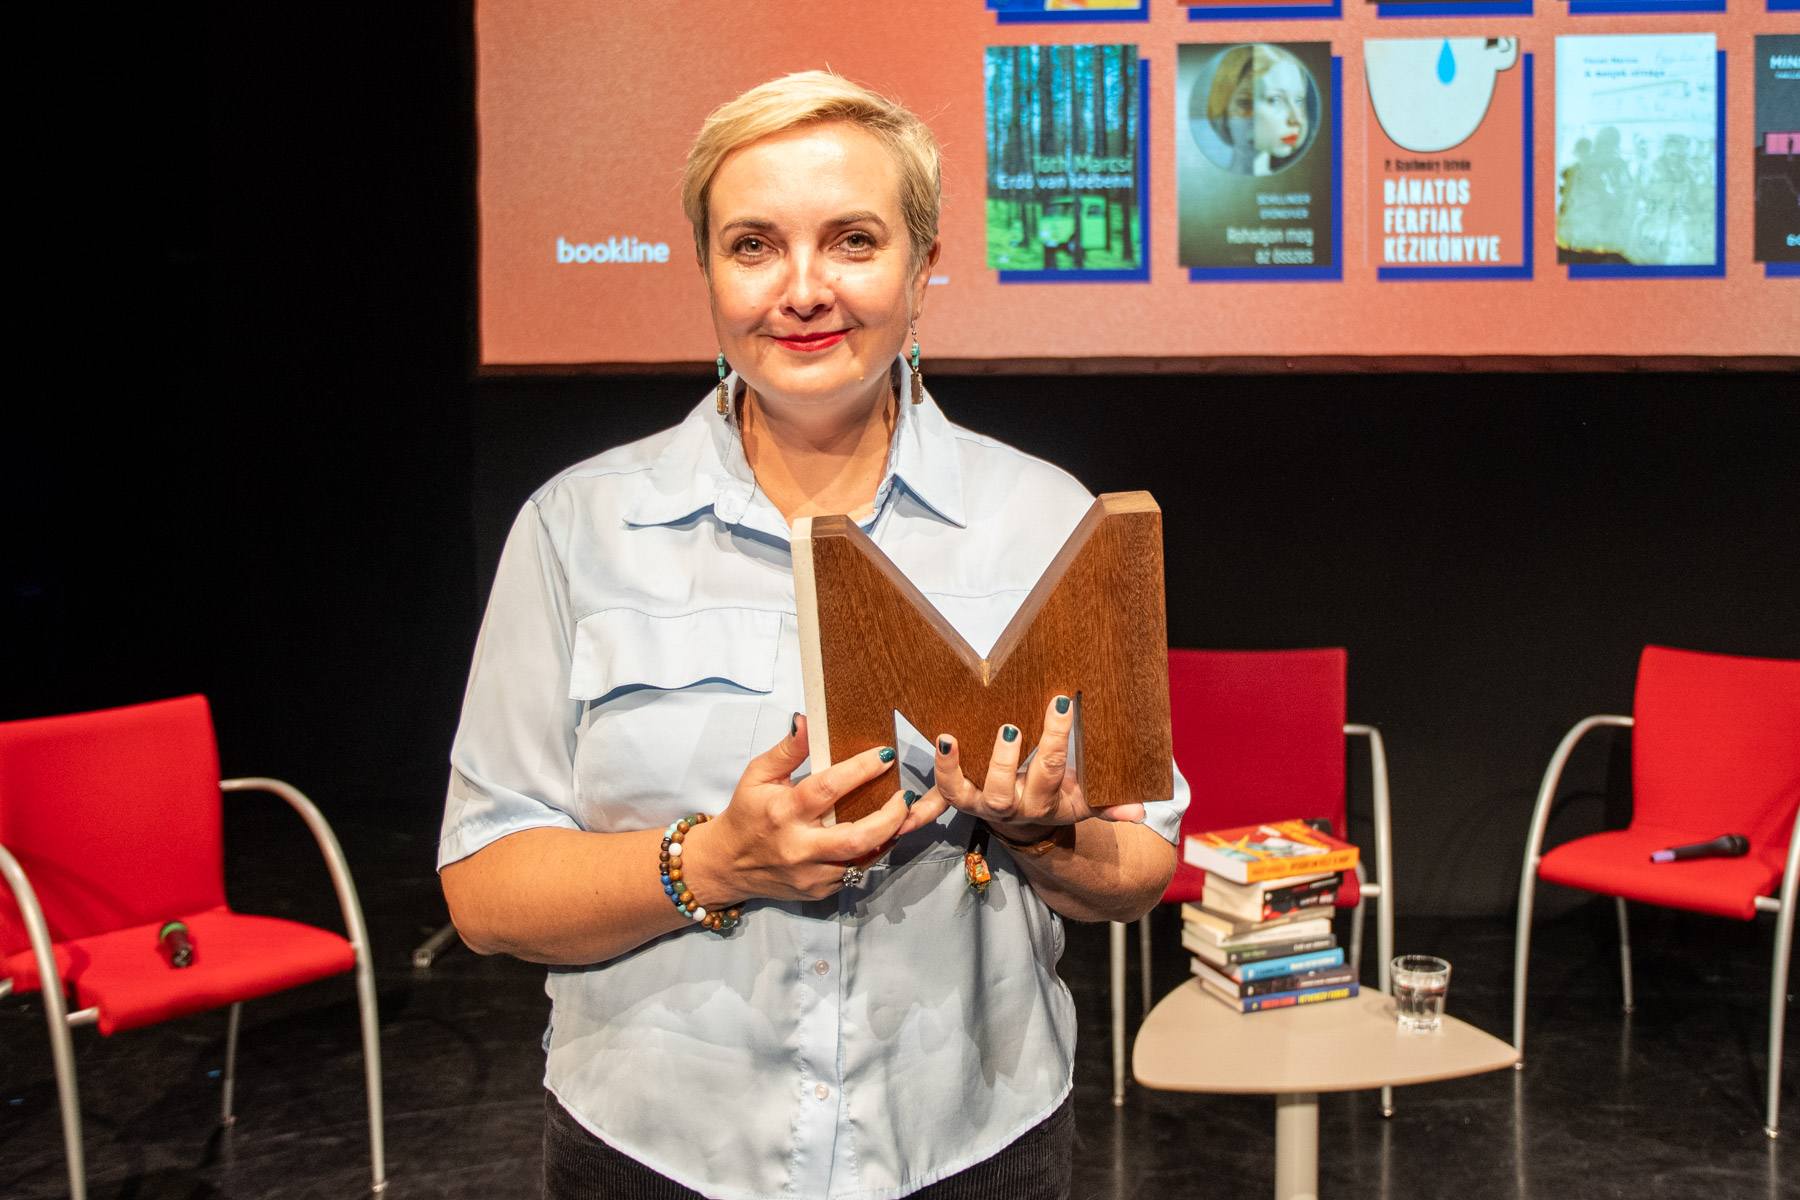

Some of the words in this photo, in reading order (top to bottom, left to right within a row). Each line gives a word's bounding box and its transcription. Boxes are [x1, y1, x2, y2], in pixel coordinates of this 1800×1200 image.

[1037, 176, 1067, 190] van
[1384, 175, 1471, 205] BÁNATOS
[1384, 205, 1464, 234] FÉRFIAK
[556, 236, 671, 263] bookline
[1286, 229, 1314, 247] meg
[1384, 234, 1501, 263] KÉZIKÖNYVE
